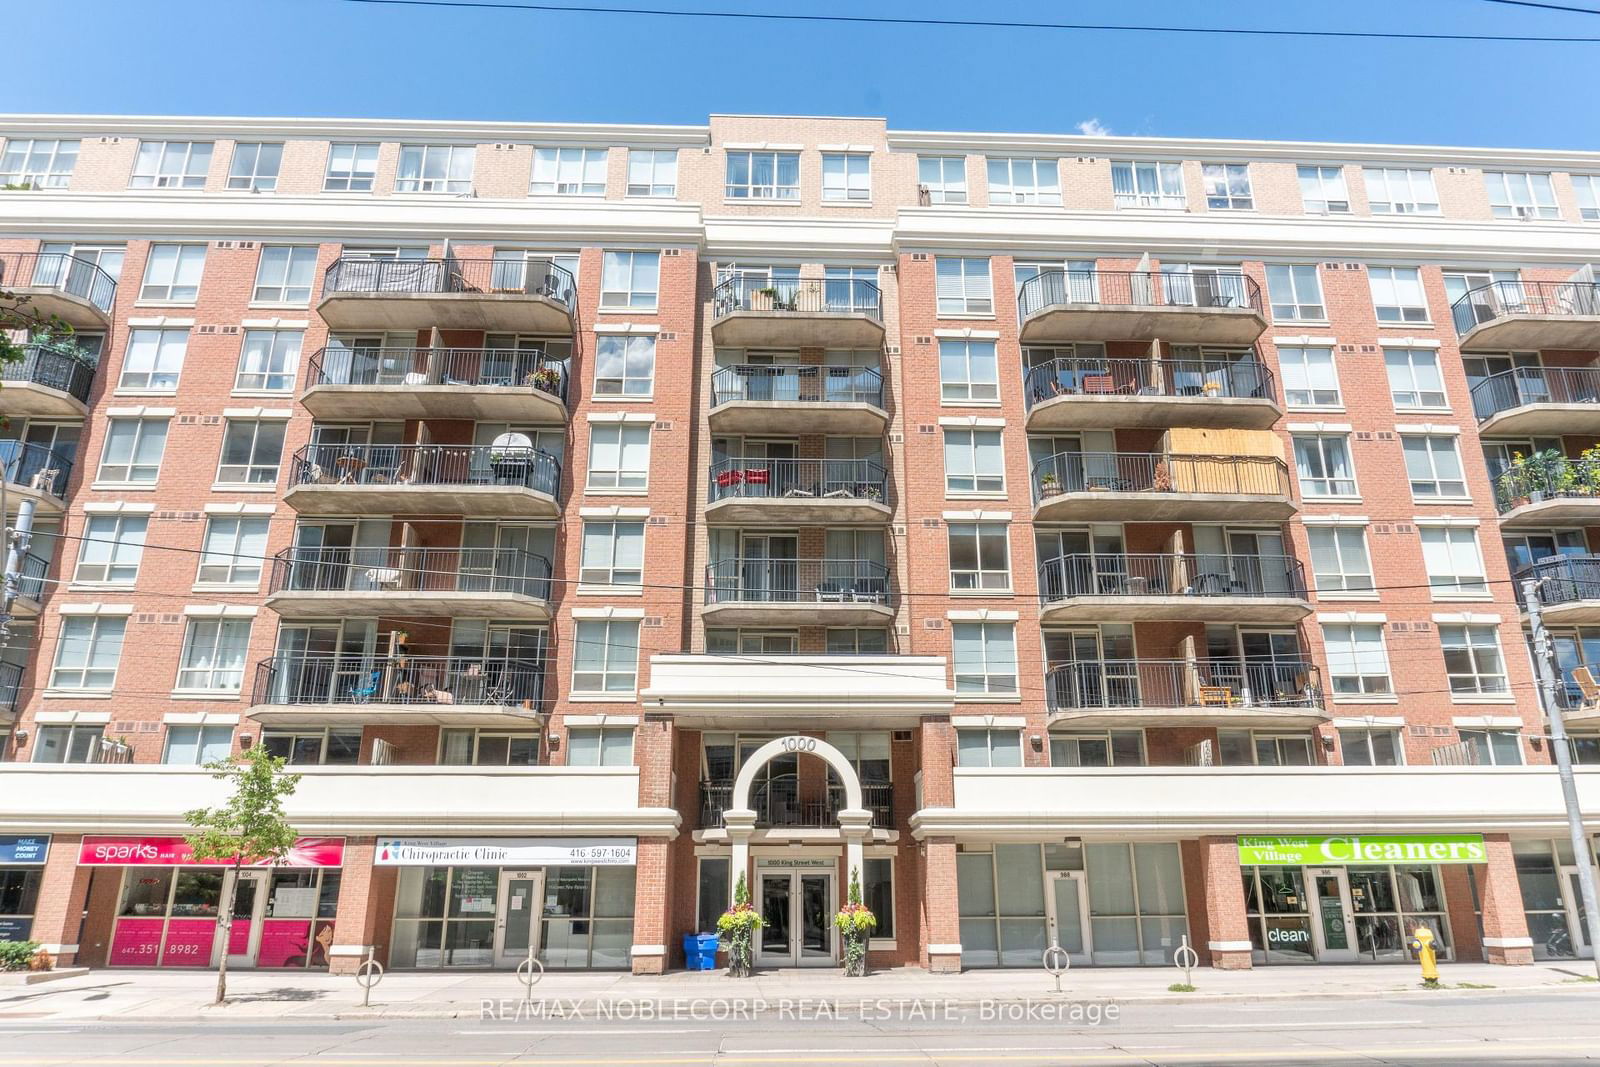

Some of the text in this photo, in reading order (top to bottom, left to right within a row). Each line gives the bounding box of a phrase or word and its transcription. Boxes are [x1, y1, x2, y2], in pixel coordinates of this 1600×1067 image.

[782, 738, 816, 752] 1000
[1242, 838, 1309, 850] King West
[1320, 837, 1483, 860] Cleaners
[401, 848, 508, 863] Chiropractic Clinic
[1253, 850, 1303, 863] Village
[1268, 928, 1309, 942] clean
